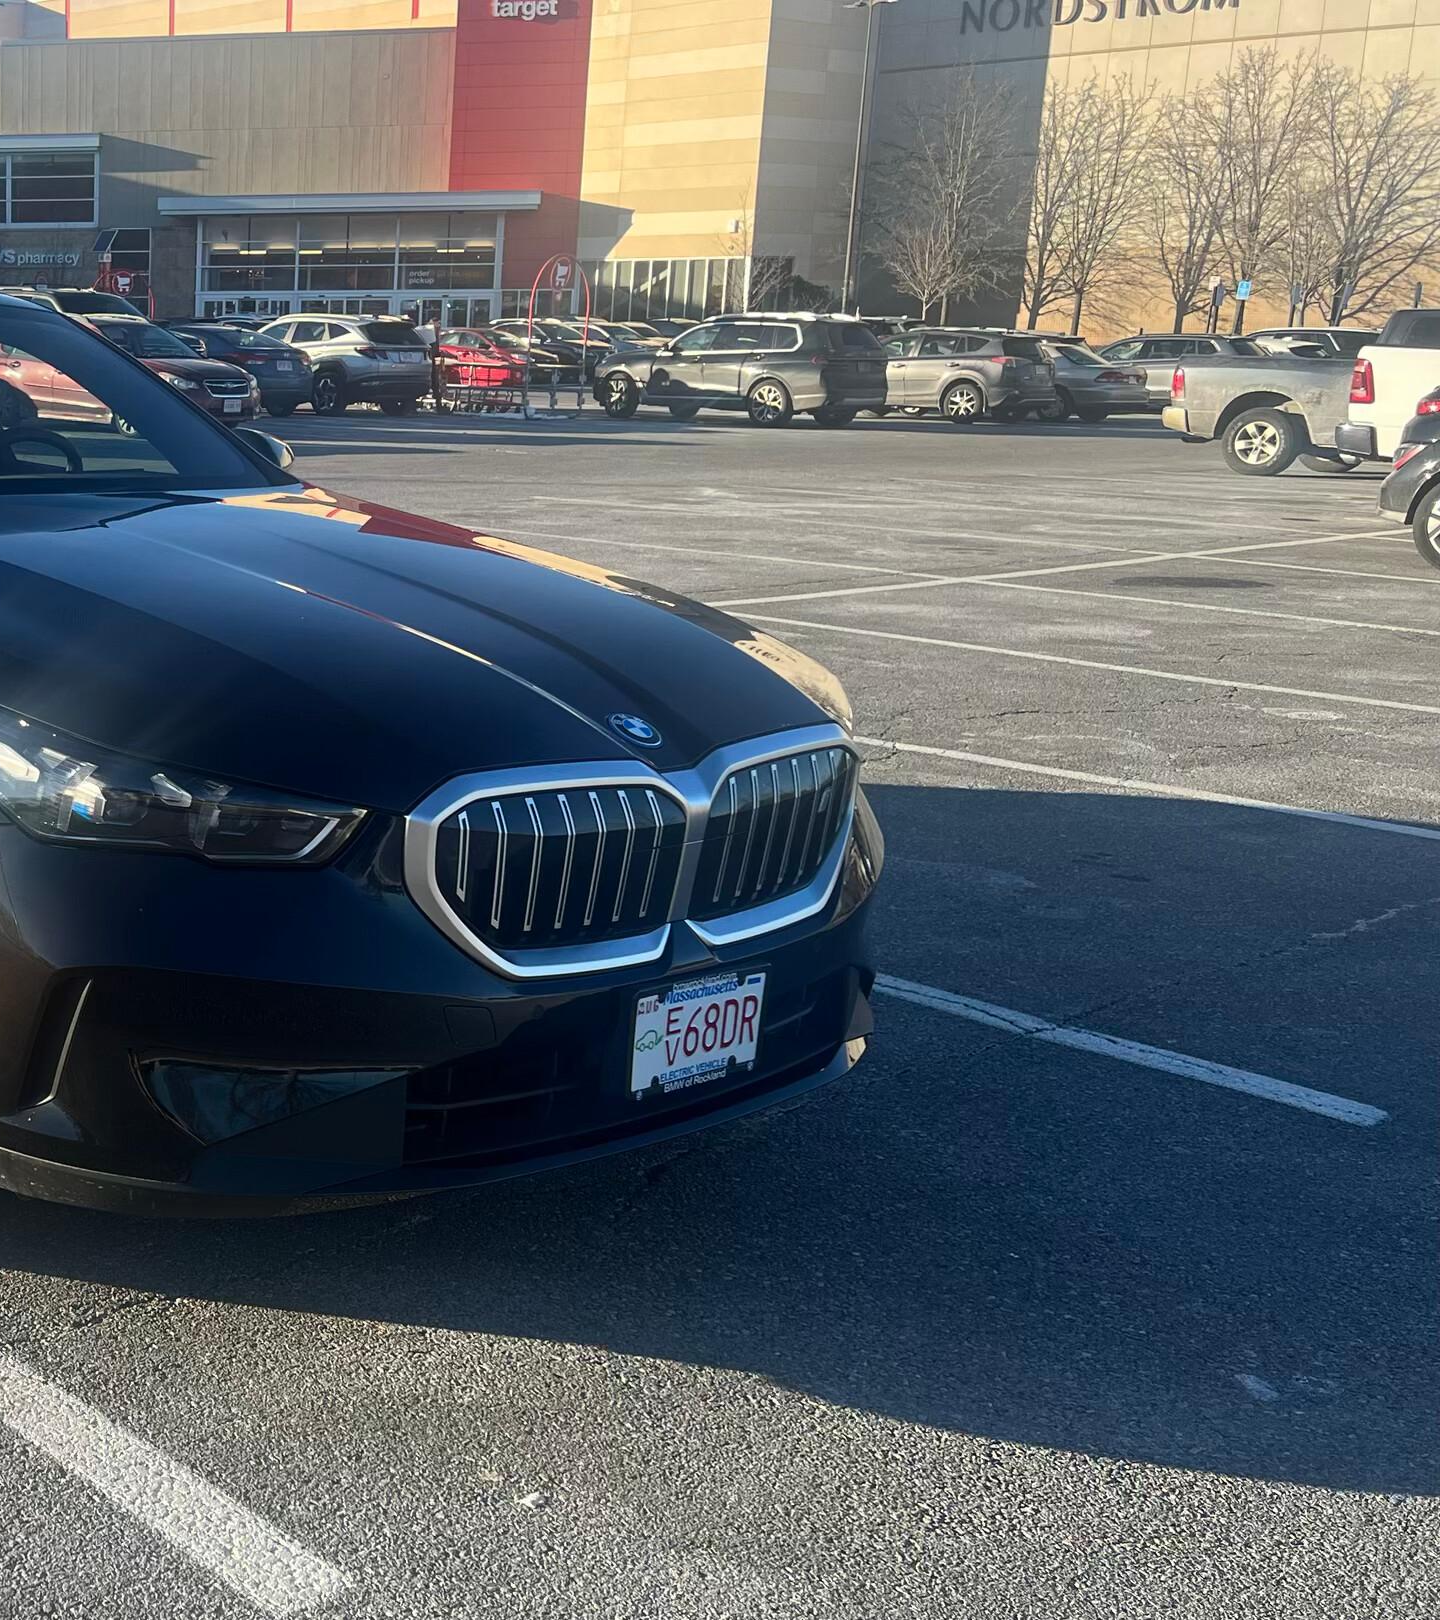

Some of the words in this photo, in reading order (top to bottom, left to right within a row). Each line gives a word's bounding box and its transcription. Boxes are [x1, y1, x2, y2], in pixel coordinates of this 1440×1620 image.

[490, 0, 558, 21] target
[17, 251, 80, 267] pharmacy
[663, 981, 738, 1005] Massachusetts
[660, 1065, 694, 1082] ELECTRIC
[695, 1057, 727, 1073] VEHICLE
[663, 1079, 684, 1093] BMW
[684, 1077, 692, 1088] of
[692, 1067, 727, 1085] Rockland
